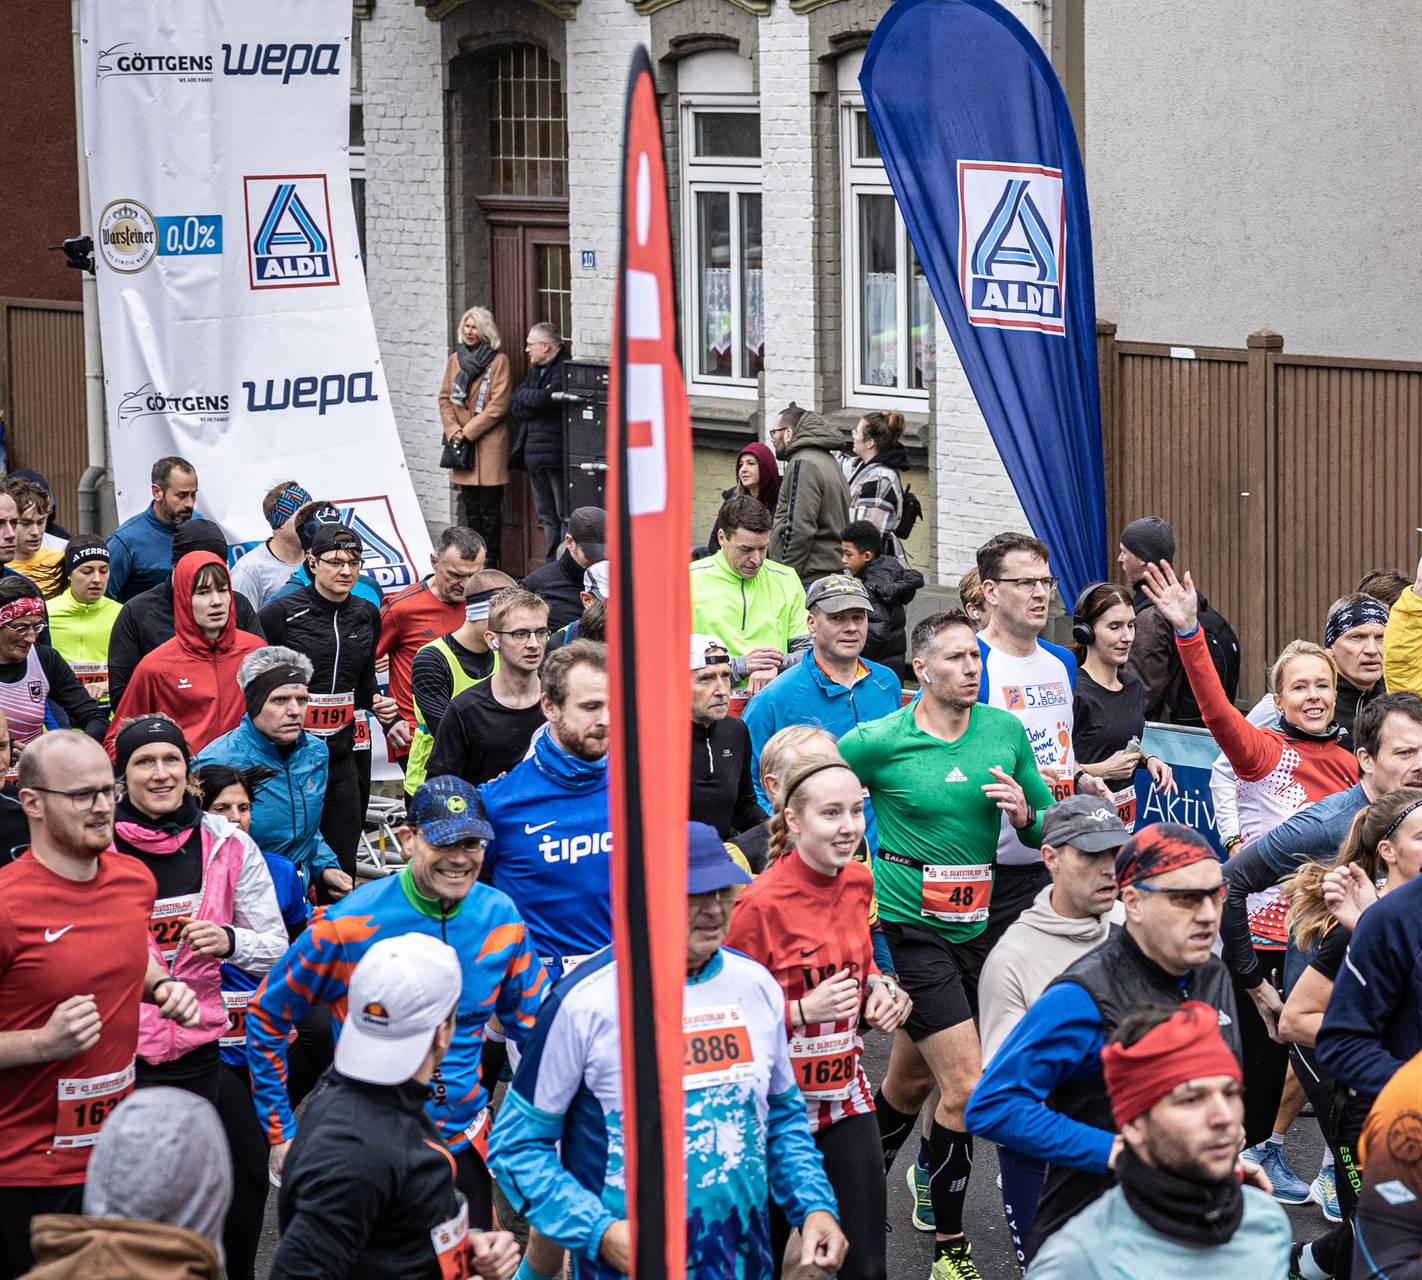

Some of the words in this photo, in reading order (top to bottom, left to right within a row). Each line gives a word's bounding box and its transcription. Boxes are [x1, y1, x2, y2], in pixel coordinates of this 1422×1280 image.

[117, 53, 213, 72] GÖTTGENS
[221, 43, 341, 85] wepa
[102, 226, 154, 248] Warsteiner
[166, 216, 215, 255] 0,0%
[263, 257, 325, 279] ALDI
[583, 251, 594, 267] 10
[981, 282, 1055, 315] ALDI
[146, 392, 229, 412] GÖTTGENS
[242, 371, 378, 416] wepa
[311, 708, 347, 724] 1191
[1142, 782, 1217, 831] Aktiv
[940, 870, 949, 878] 42.
[950, 869, 982, 877] SILVESTERLAUF
[949, 886, 974, 907] 48
[801, 1055, 853, 1085] 1628
